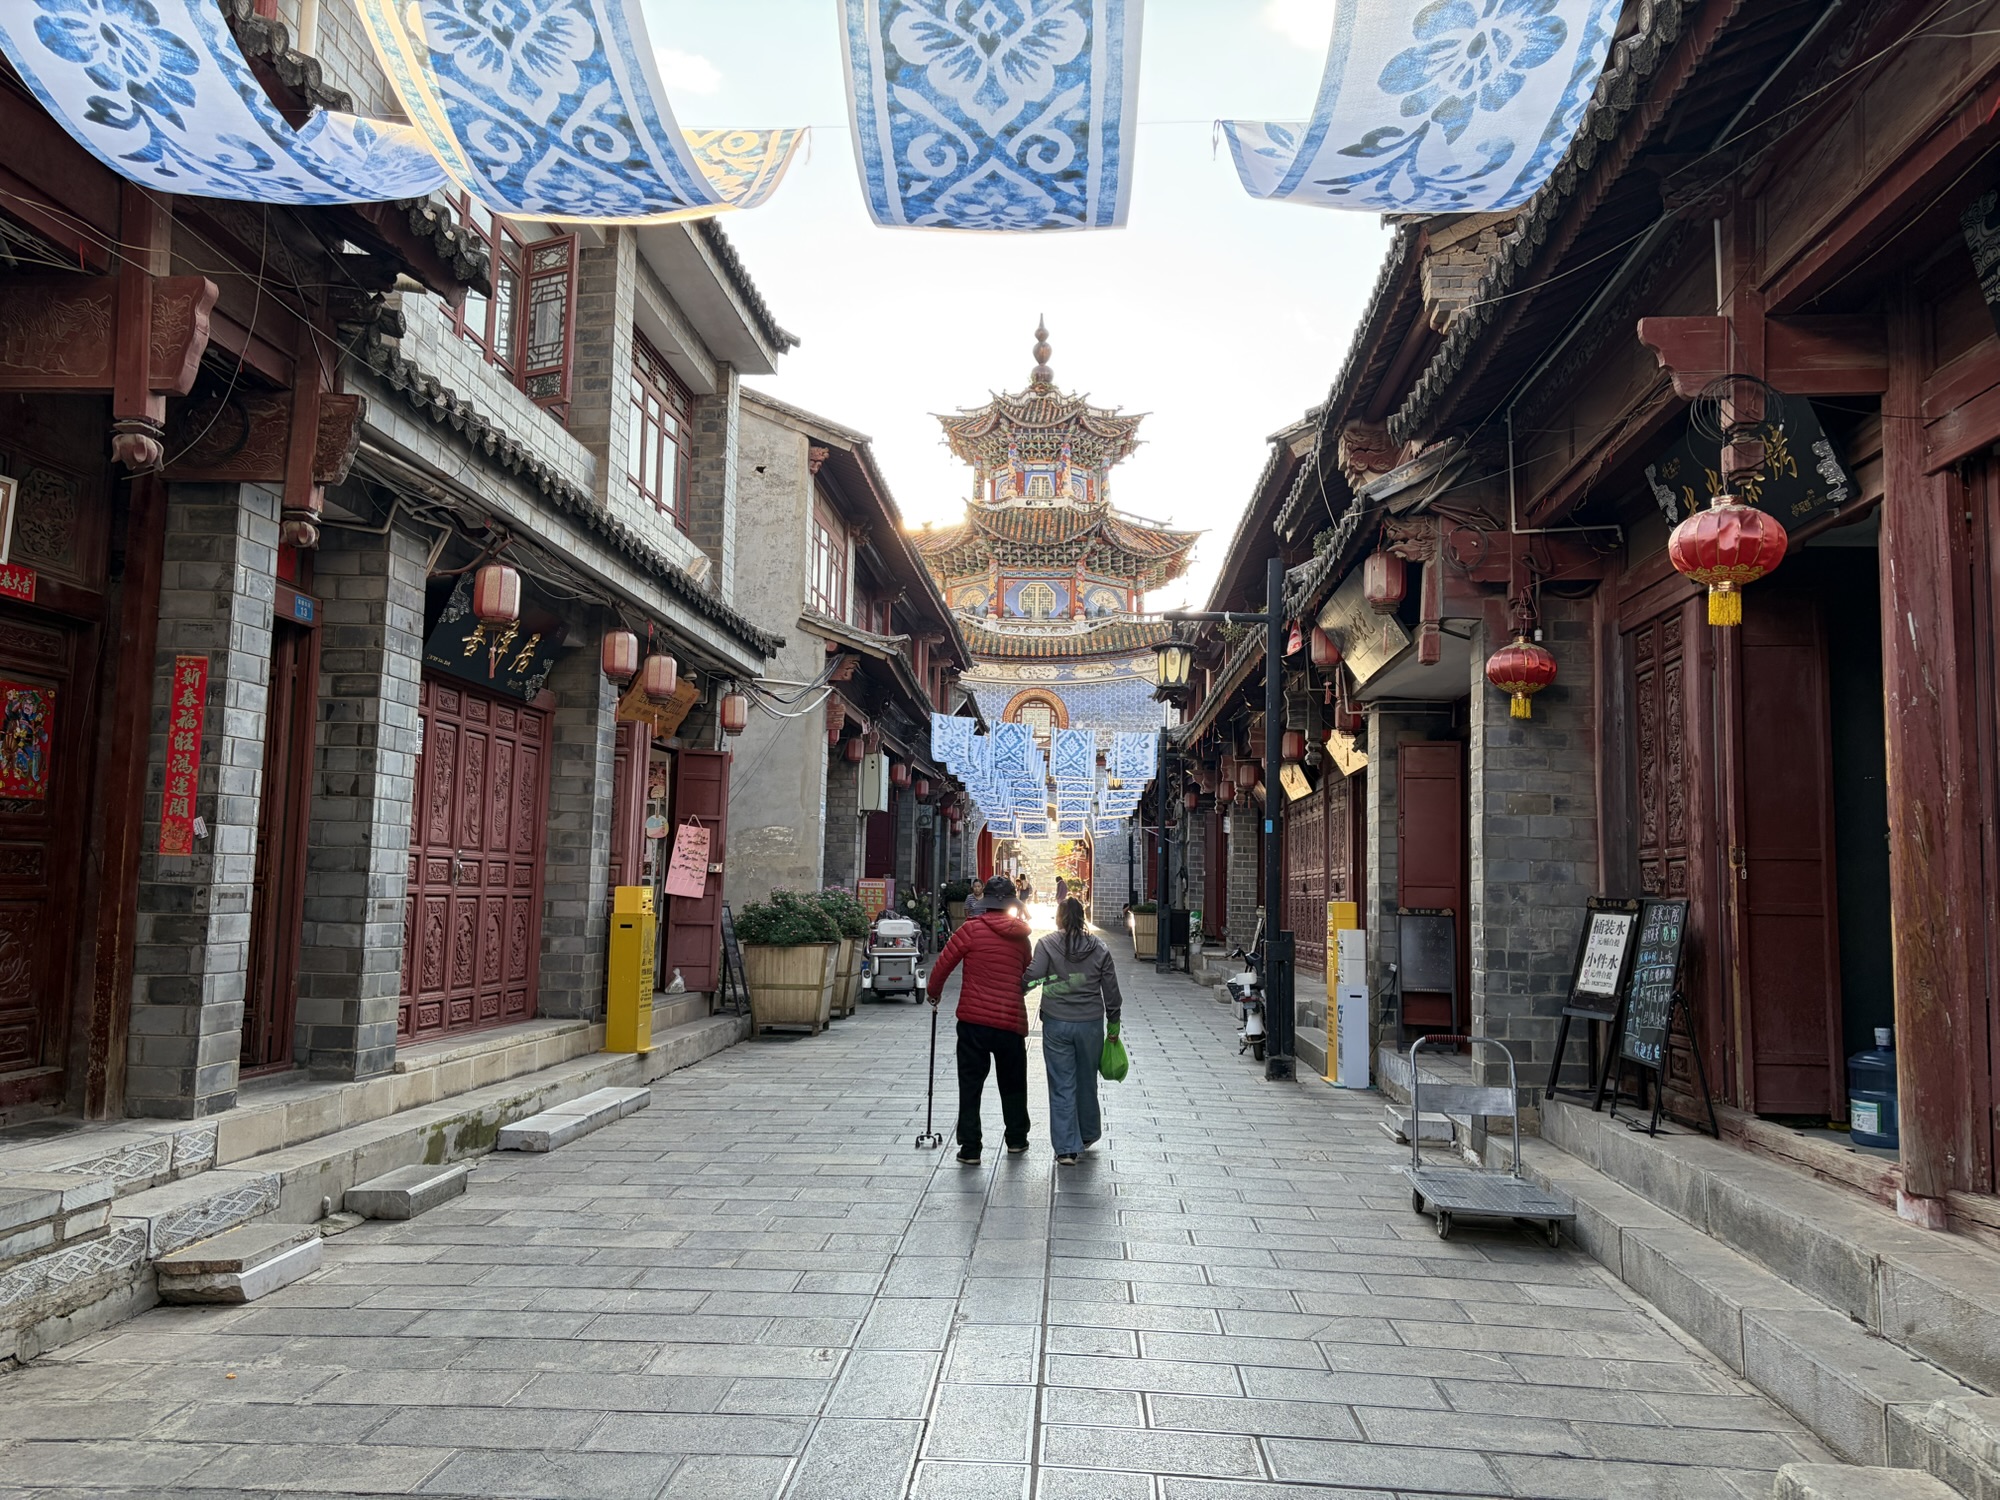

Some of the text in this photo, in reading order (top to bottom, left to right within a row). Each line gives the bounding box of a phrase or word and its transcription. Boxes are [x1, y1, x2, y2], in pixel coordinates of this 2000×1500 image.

[0, 569, 32, 594] 春大吉
[1592, 918, 1627, 936] 桶装水
[1585, 952, 1619, 970] 小件水
